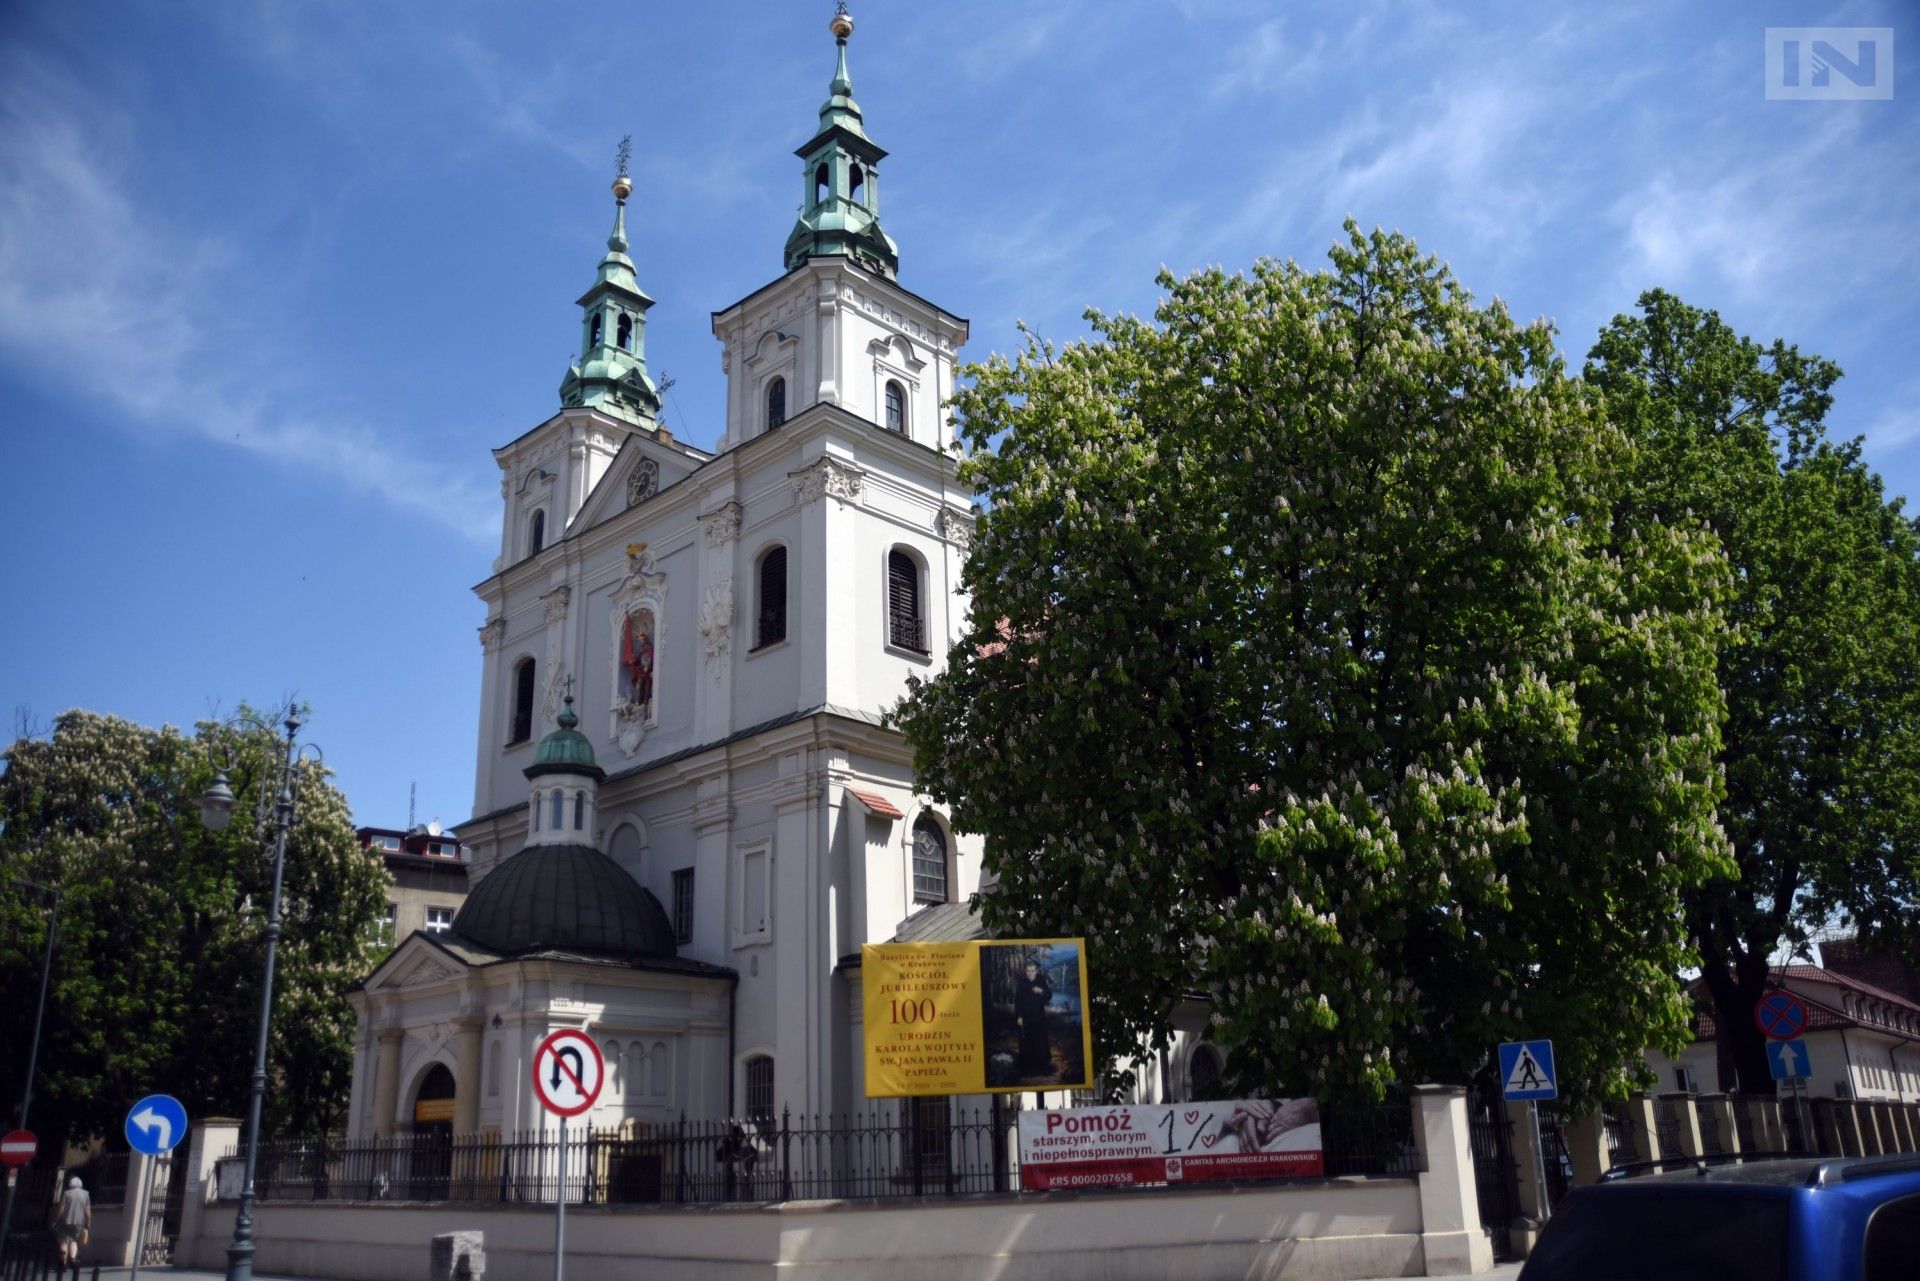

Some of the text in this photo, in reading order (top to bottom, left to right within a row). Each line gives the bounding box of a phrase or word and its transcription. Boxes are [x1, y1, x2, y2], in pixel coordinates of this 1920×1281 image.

[880, 982, 968, 994] JUBILEUSZOWY
[900, 1031, 951, 1040] URODZIN
[875, 1044, 920, 1053] KAROLA
[898, 1056, 923, 1067] JANA
[964, 1055, 971, 1063] II
[1046, 1108, 1132, 1134] Pomóż
[1032, 1131, 1147, 1147] starszym, chorym
[1024, 1145, 1156, 1162] i niepełnosprawnym.
[1184, 1153, 1318, 1166] CARITAS ARCHIDIECEZJI KRAKOWSKIEJ
[1049, 1173, 1133, 1186] KRS 0000207658
